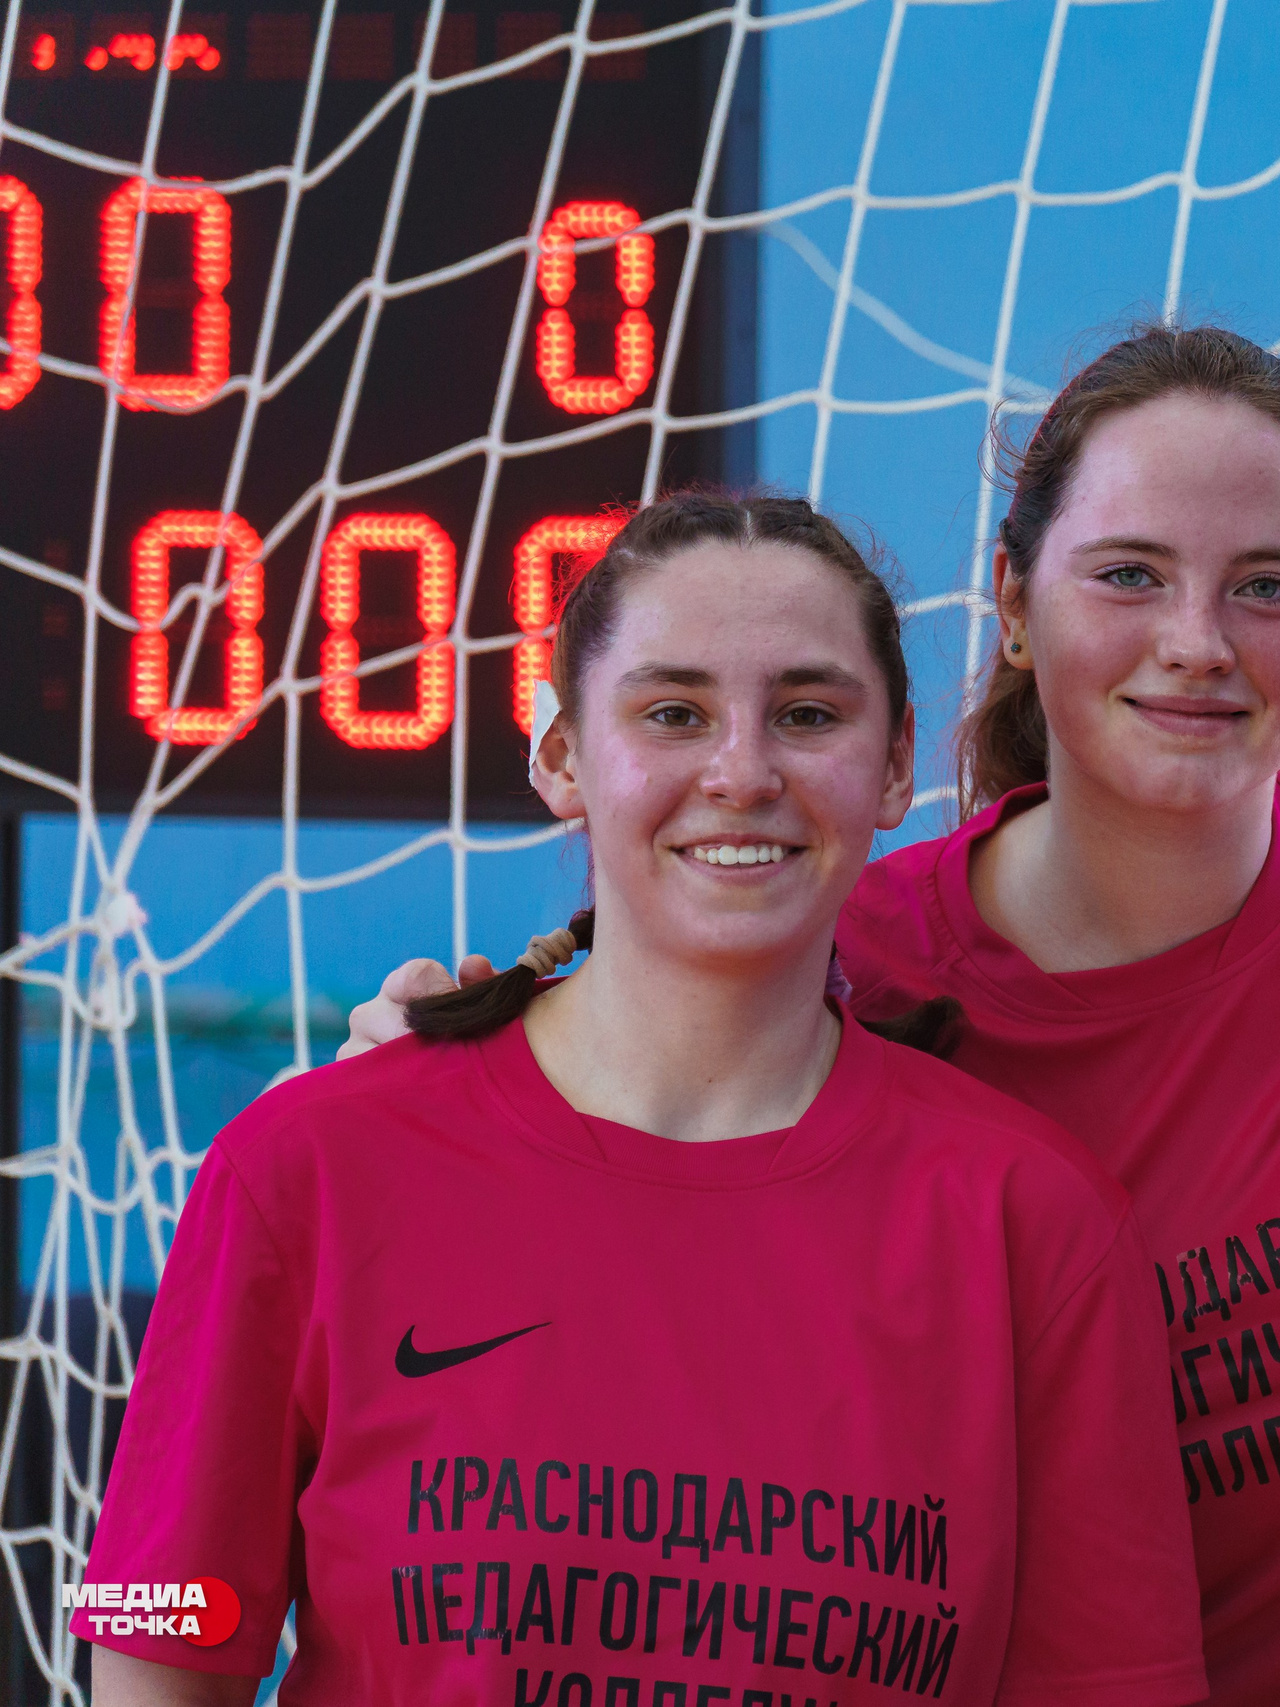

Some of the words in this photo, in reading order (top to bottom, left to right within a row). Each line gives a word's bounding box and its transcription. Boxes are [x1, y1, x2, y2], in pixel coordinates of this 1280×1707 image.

[536, 201, 655, 415] 0
[407, 1456, 948, 1590] КРАСНОДАРСКИЙ
[391, 1561, 960, 1699] ПЕДАГОГИЧЕСКИЙ
